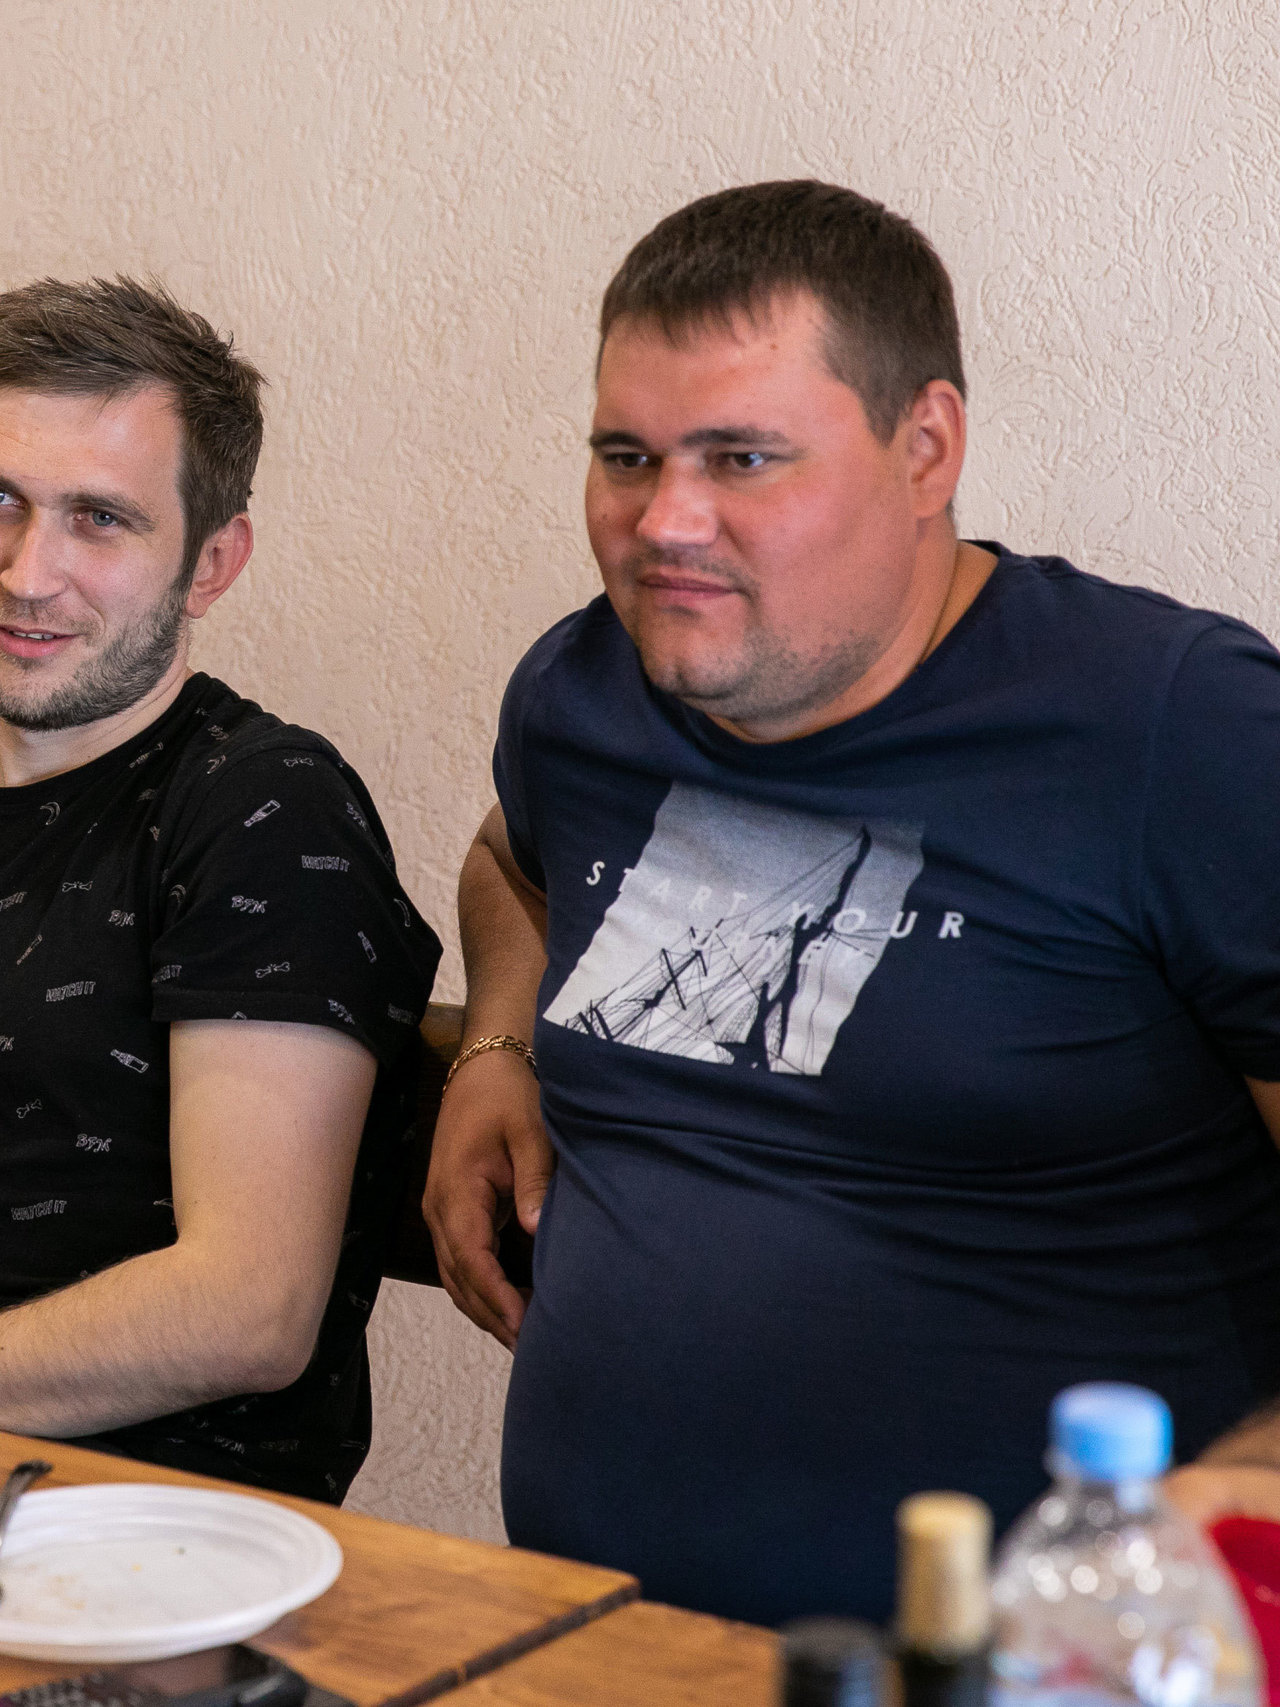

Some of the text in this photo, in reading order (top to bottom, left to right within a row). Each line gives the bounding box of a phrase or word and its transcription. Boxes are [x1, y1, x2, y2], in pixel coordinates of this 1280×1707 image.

[301, 855, 350, 873] WATCH IT
[586, 861, 965, 940] START YOUR
[46, 980, 96, 1002] WATCH IT
[11, 1199, 68, 1221] WATCH IT
